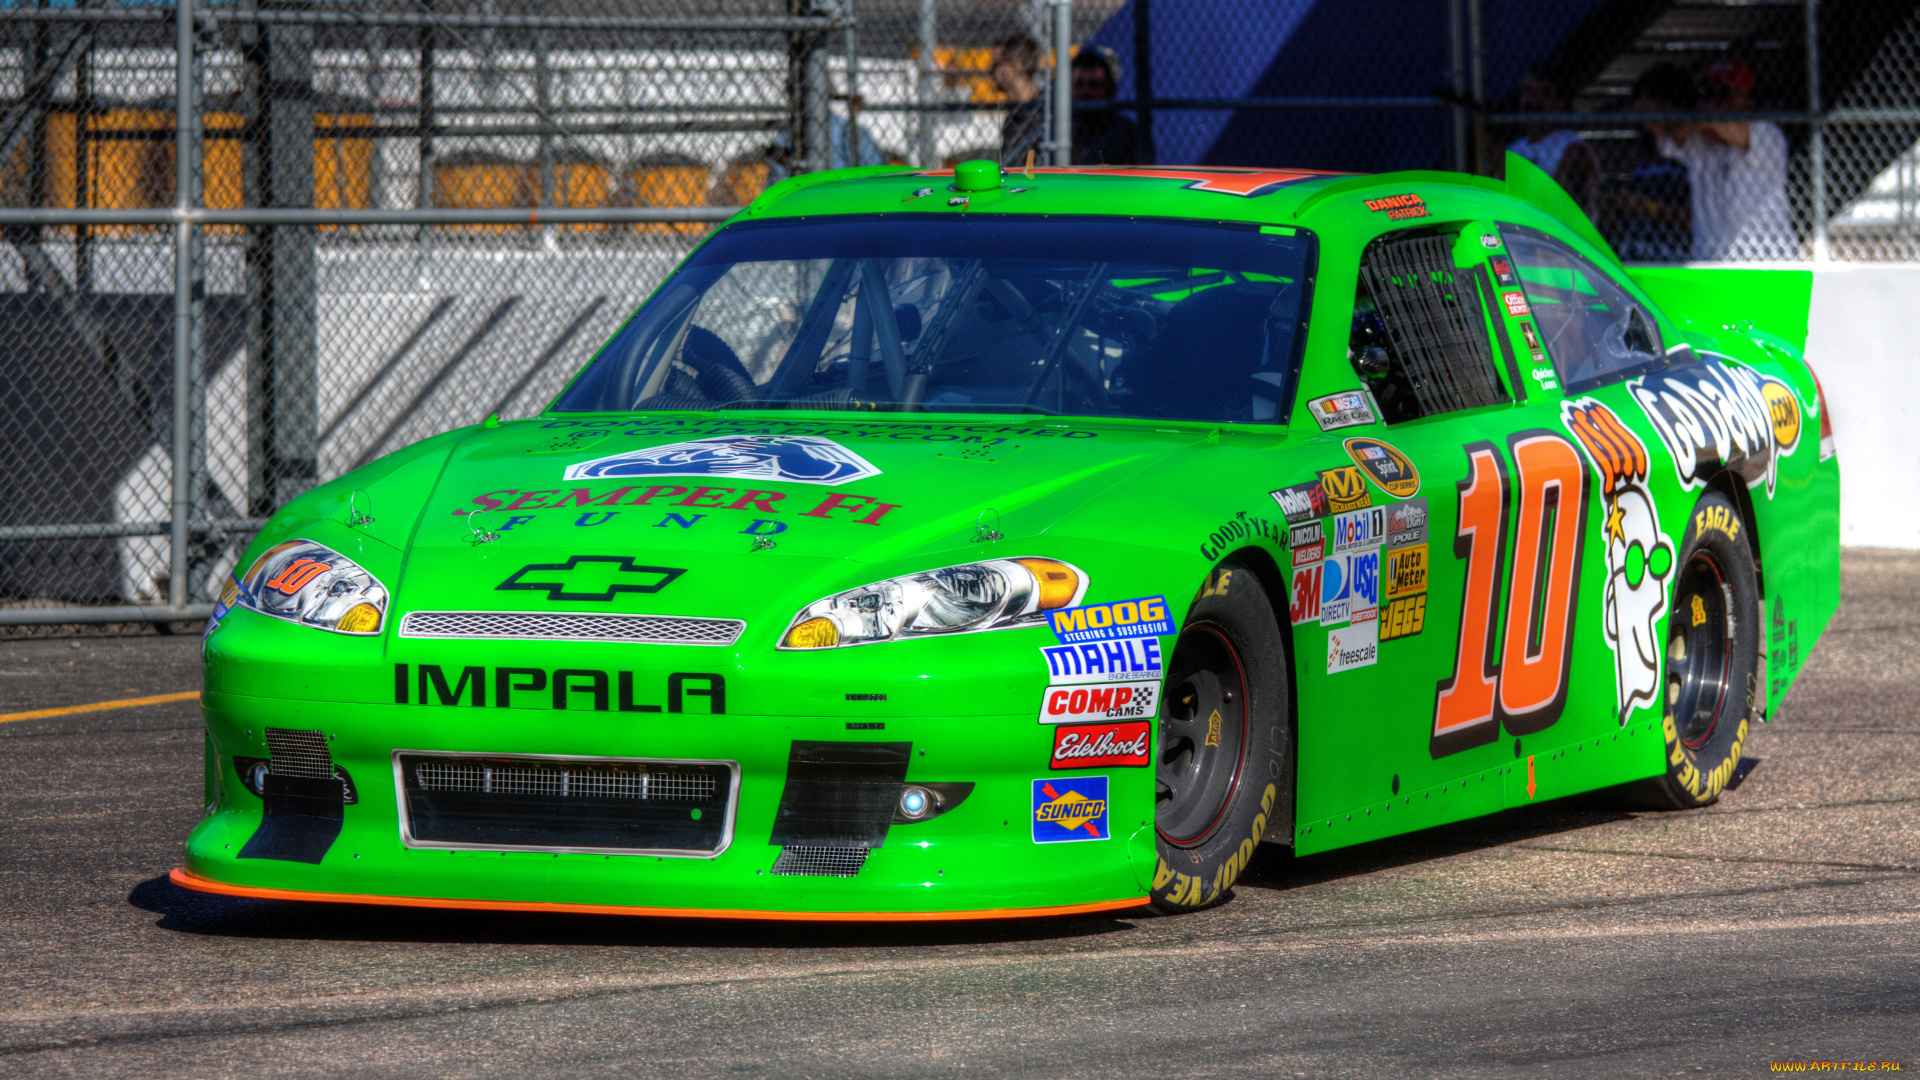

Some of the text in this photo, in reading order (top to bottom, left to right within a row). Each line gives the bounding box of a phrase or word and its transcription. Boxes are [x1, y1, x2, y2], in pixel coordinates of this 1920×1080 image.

[1364, 193, 1424, 211] DANICA
[1386, 206, 1431, 221] PATRICK
[1540, 379, 1557, 391] Loans
[1334, 396, 1363, 412] NASCAR
[853, 423, 1098, 438] MATCHED
[1323, 415, 1351, 425] RACE
[1636, 361, 1776, 492] GoDaddy
[624, 428, 1008, 445] GODADDY.COM
[1375, 460, 1399, 478] Sprint
[1389, 480, 1416, 491] CUP SERIES
[452, 485, 903, 526] SEMPER FI
[1271, 488, 1314, 518] Holley
[1336, 511, 1381, 546] Mobil 1
[1406, 512, 1426, 530] LIGHT
[1695, 505, 1741, 543] EAGLE
[1200, 514, 1289, 562] GOODYEAR
[1290, 525, 1321, 546] LINCOLN
[1393, 530, 1421, 545] POLE
[1296, 546, 1322, 564] WELDERS
[1399, 551, 1421, 570] Auto
[265, 559, 332, 597] 10
[1354, 553, 1377, 605] USG
[1397, 568, 1425, 588] Meter
[1290, 566, 1322, 622] 3M
[1430, 430, 1589, 757] 10
[1053, 598, 1165, 633] MOOG
[1321, 602, 1350, 622] DIRECTV
[1352, 610, 1377, 621] SHEETROCK
[1380, 594, 1426, 642] JEGS
[1064, 621, 1168, 642] STEERING & SUSPENSION
[1043, 638, 1162, 676] MAHLE
[1339, 643, 1376, 666] freescale
[1109, 670, 1163, 681] ENGINE BEARINGS
[394, 663, 726, 714] IMPALA
[1048, 687, 1133, 715] COMP
[1106, 705, 1144, 718] CAMS
[1210, 716, 1219, 742] AERO
[1054, 731, 1147, 761] Edelbrock
[1040, 802, 1103, 819] SUNOCO
